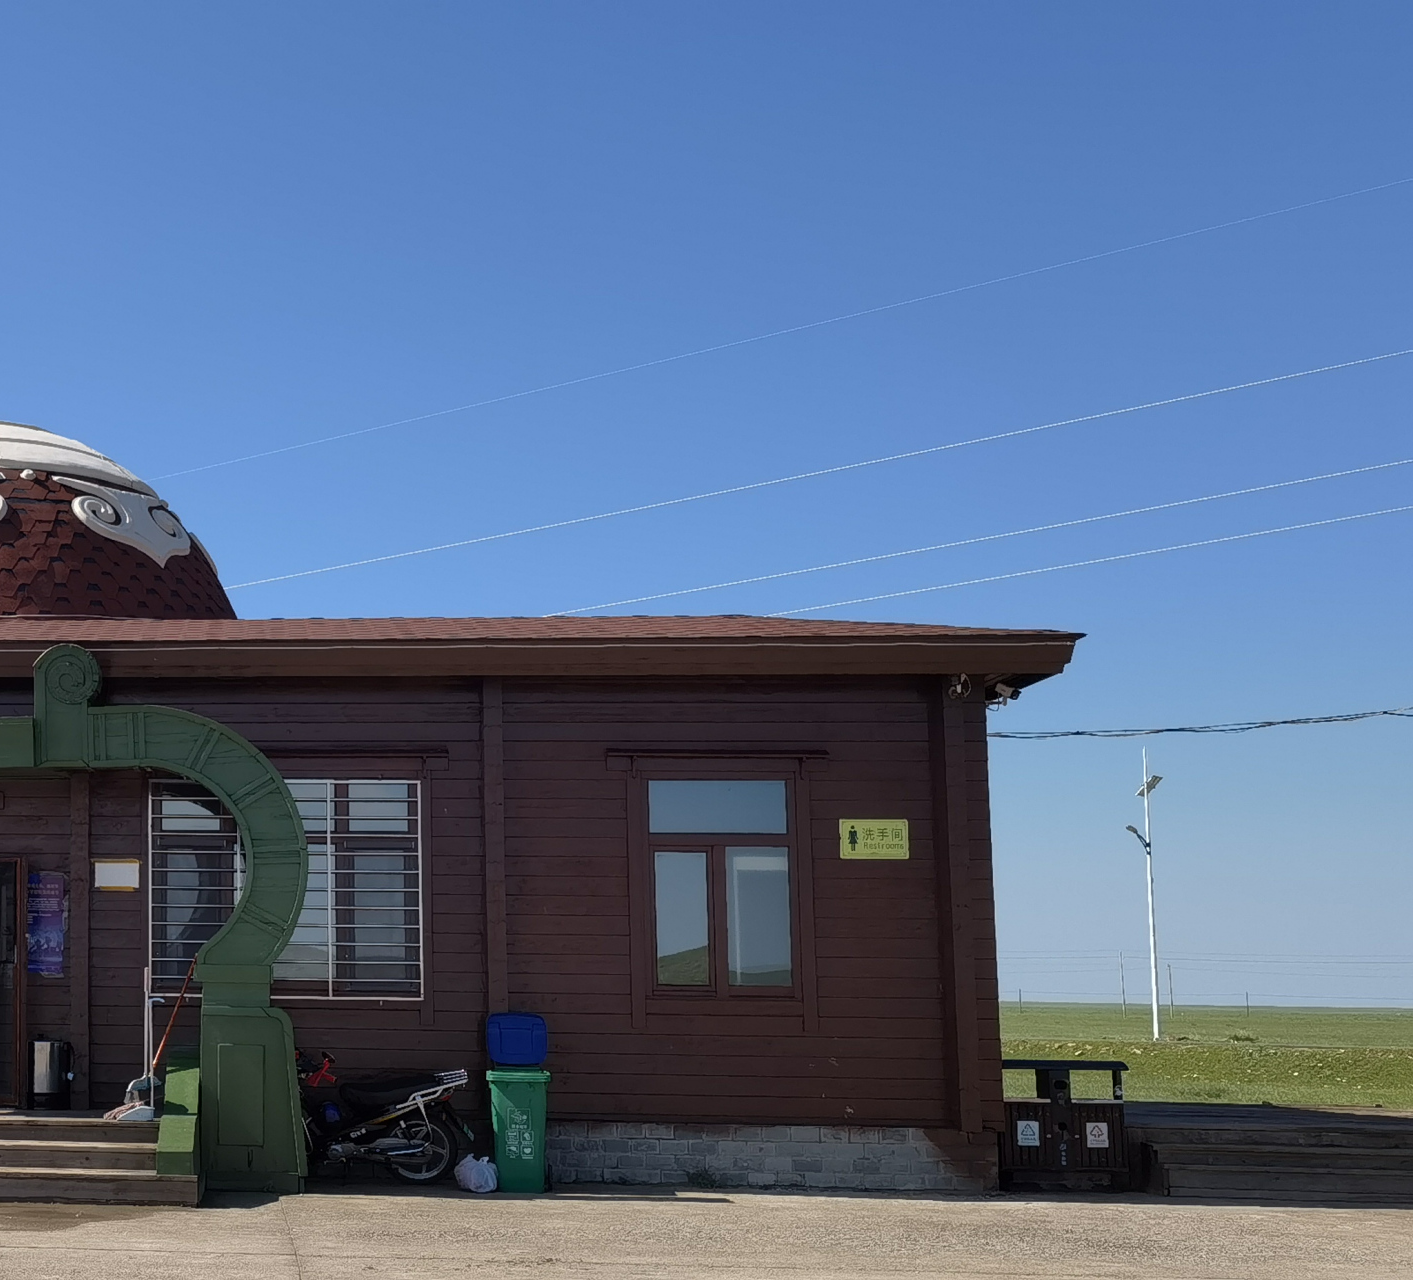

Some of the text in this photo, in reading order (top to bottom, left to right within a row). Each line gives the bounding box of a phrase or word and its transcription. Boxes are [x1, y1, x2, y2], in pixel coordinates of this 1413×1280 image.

[862, 827, 903, 841] 洗手间
[863, 842, 904, 850] Restrooms
